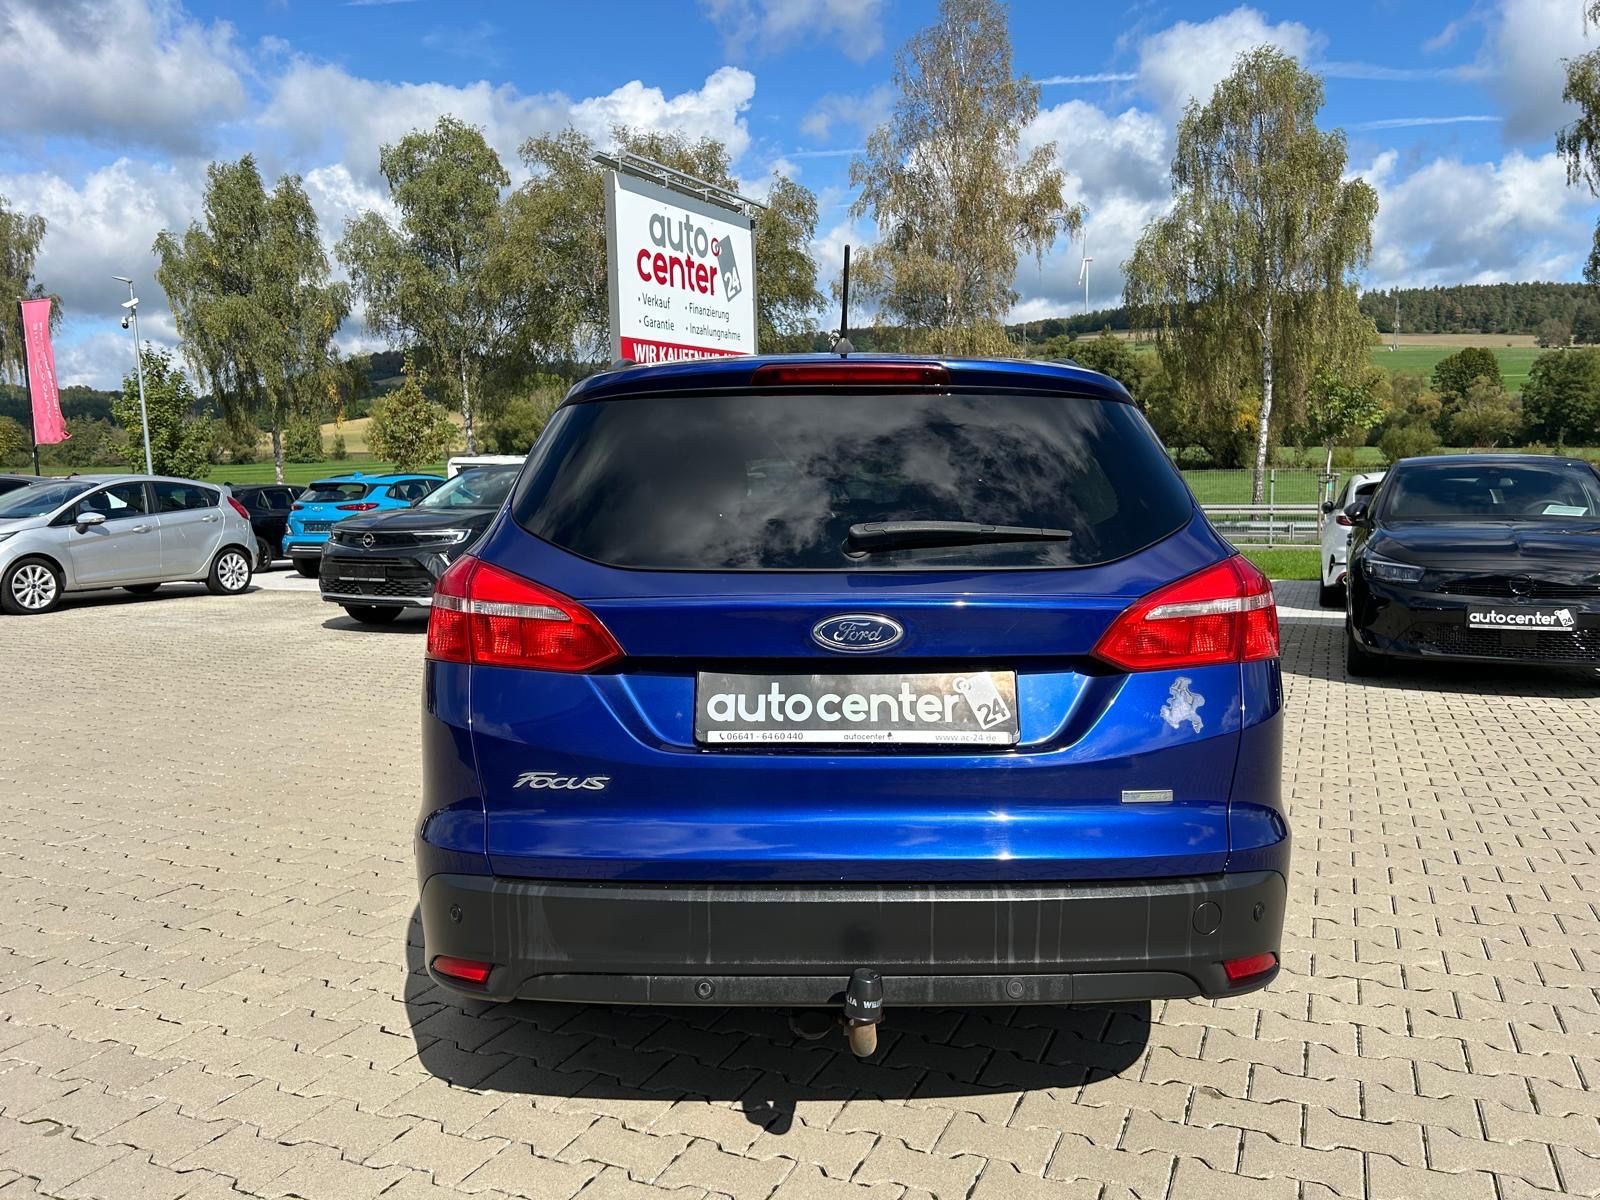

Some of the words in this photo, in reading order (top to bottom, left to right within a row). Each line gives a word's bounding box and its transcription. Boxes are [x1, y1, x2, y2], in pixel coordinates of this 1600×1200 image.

[649, 213, 709, 259] auto
[636, 248, 718, 296] center
[724, 271, 739, 298] 24
[642, 292, 671, 310] Verkauf
[643, 315, 675, 331] Garantie
[688, 302, 730, 323] Finanzierung
[689, 322, 742, 341] Inzahlungnahme
[633, 342, 657, 363] WIR
[1469, 610, 1557, 625] autocenter
[833, 621, 882, 642] Ford
[707, 682, 961, 723] autocenter
[977, 697, 1007, 726] 24
[843, 733, 885, 741] autocenter
